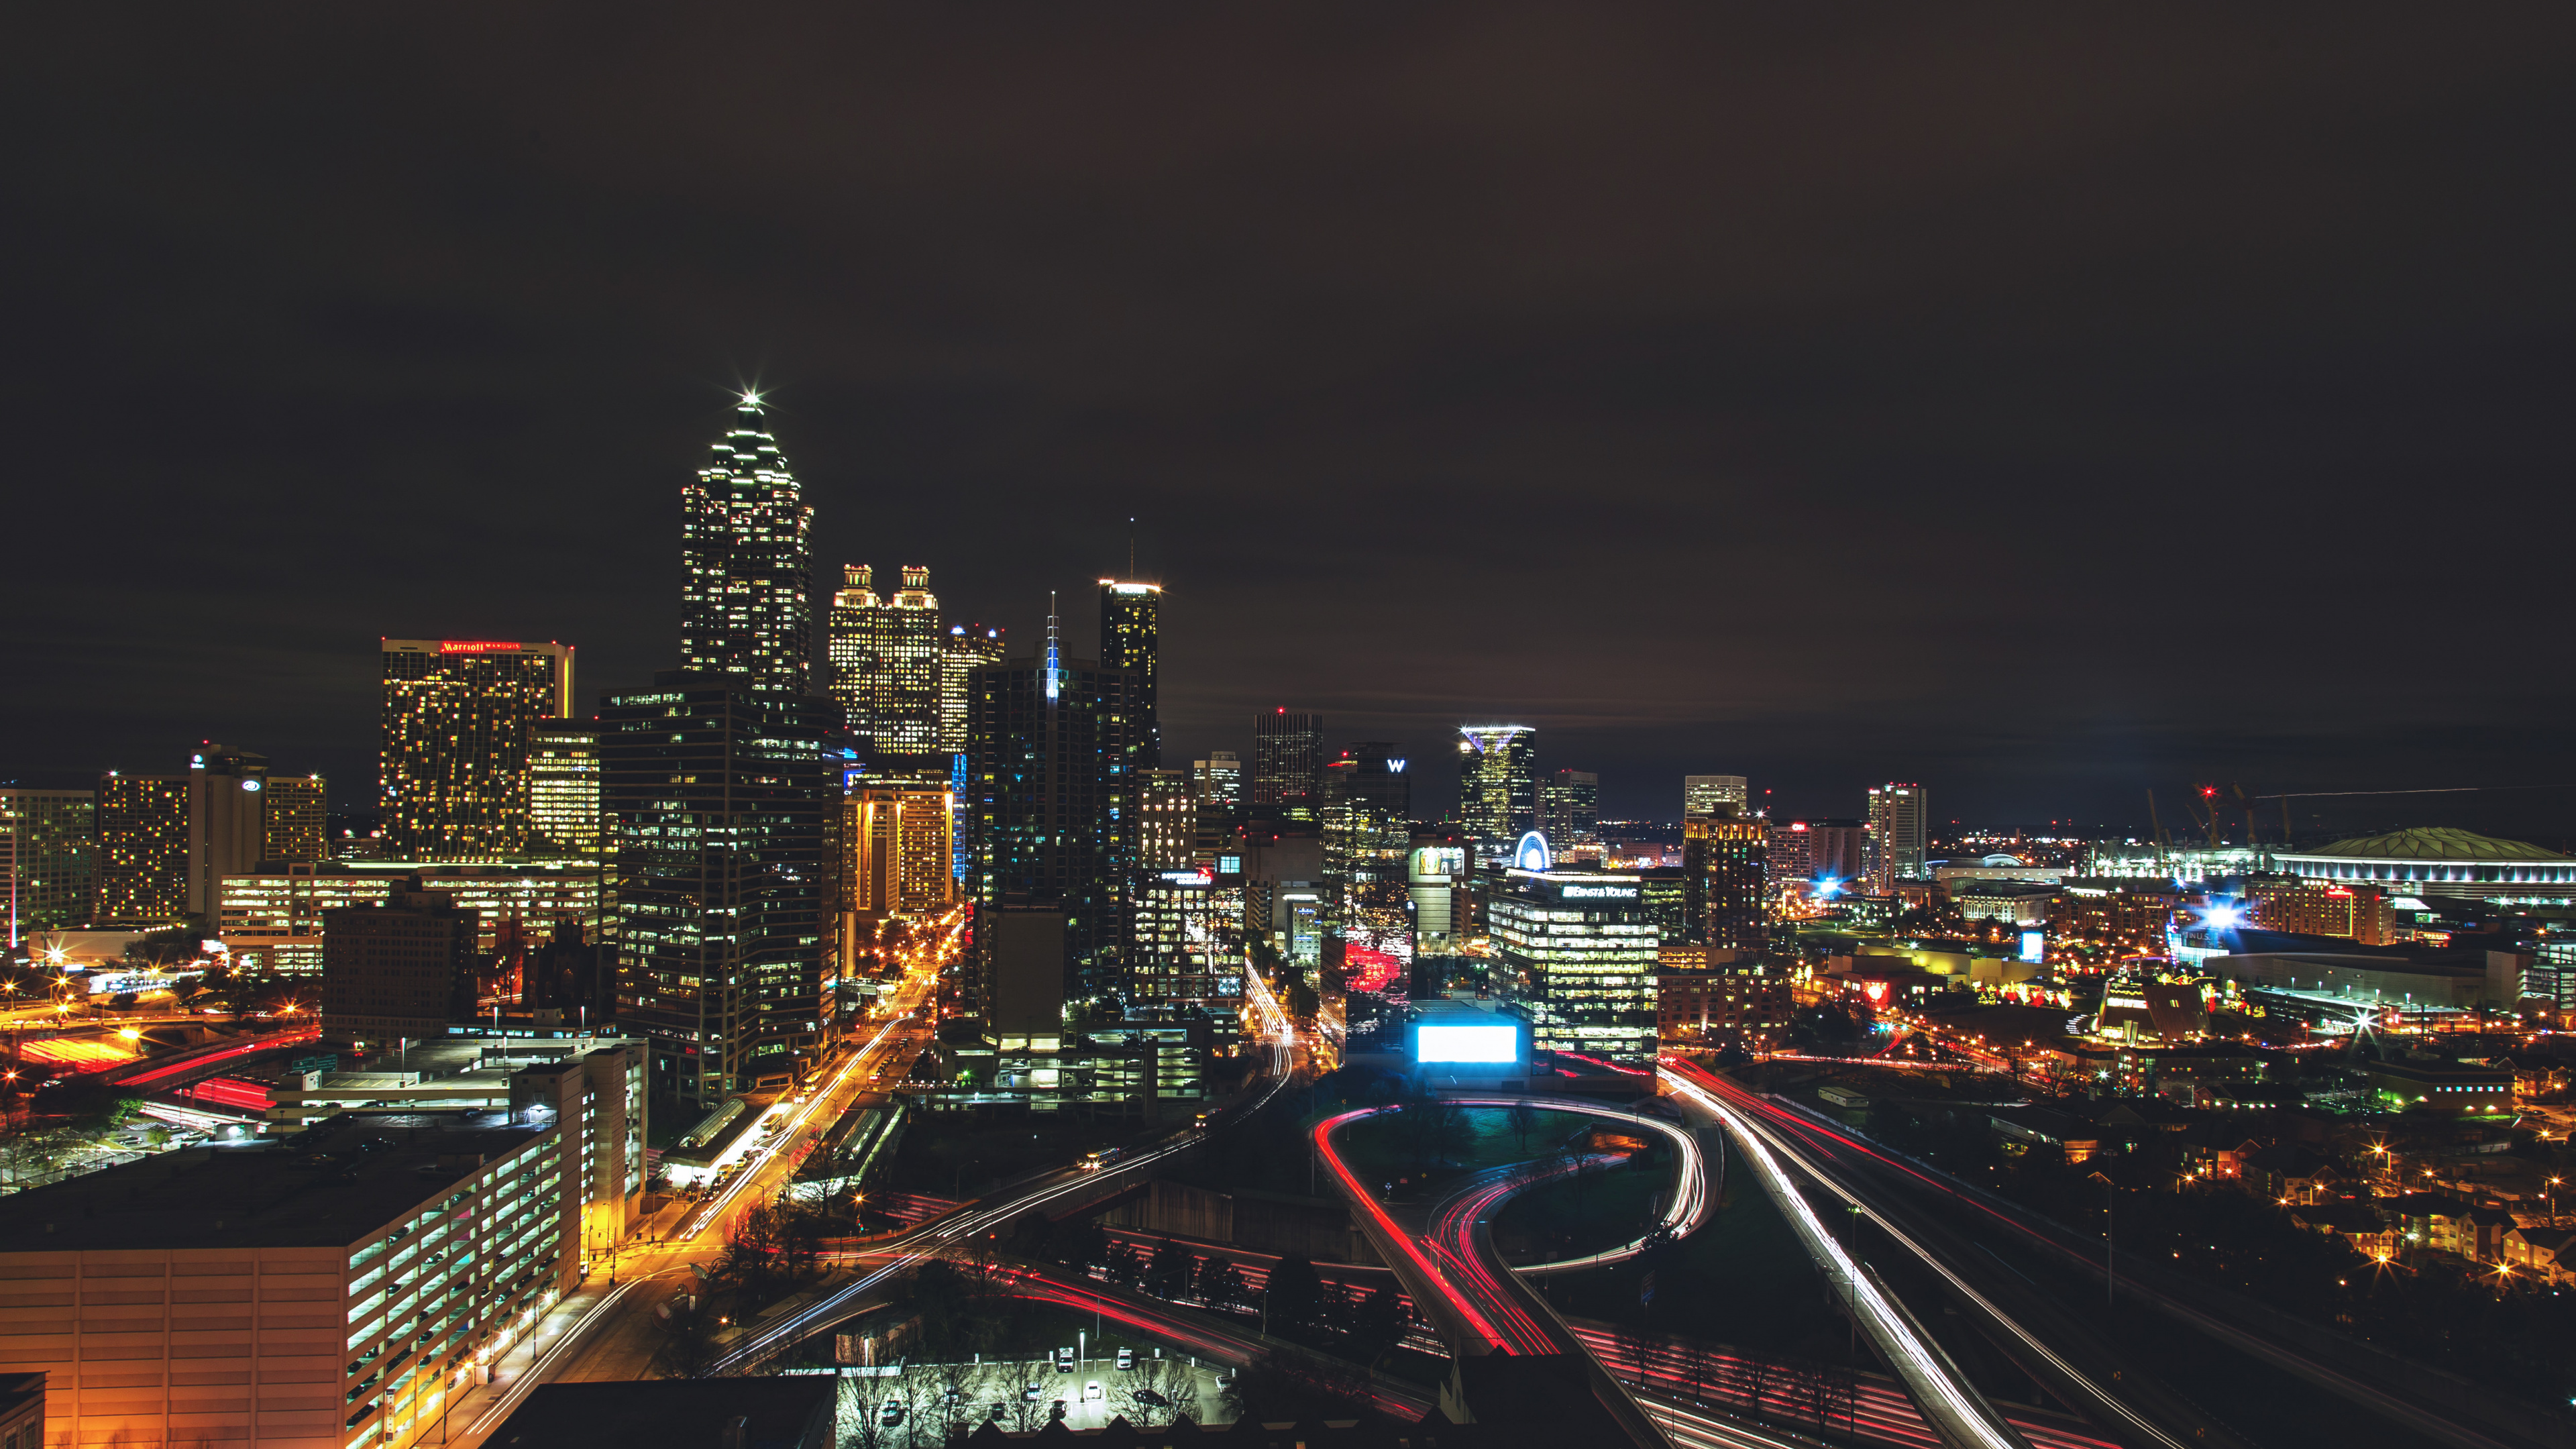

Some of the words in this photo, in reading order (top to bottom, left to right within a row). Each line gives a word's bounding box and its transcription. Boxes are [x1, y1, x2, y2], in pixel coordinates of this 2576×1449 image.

[440, 643, 484, 652] Marriott
[1387, 759, 1405, 772] W
[1605, 886, 1638, 897] YOUNG
